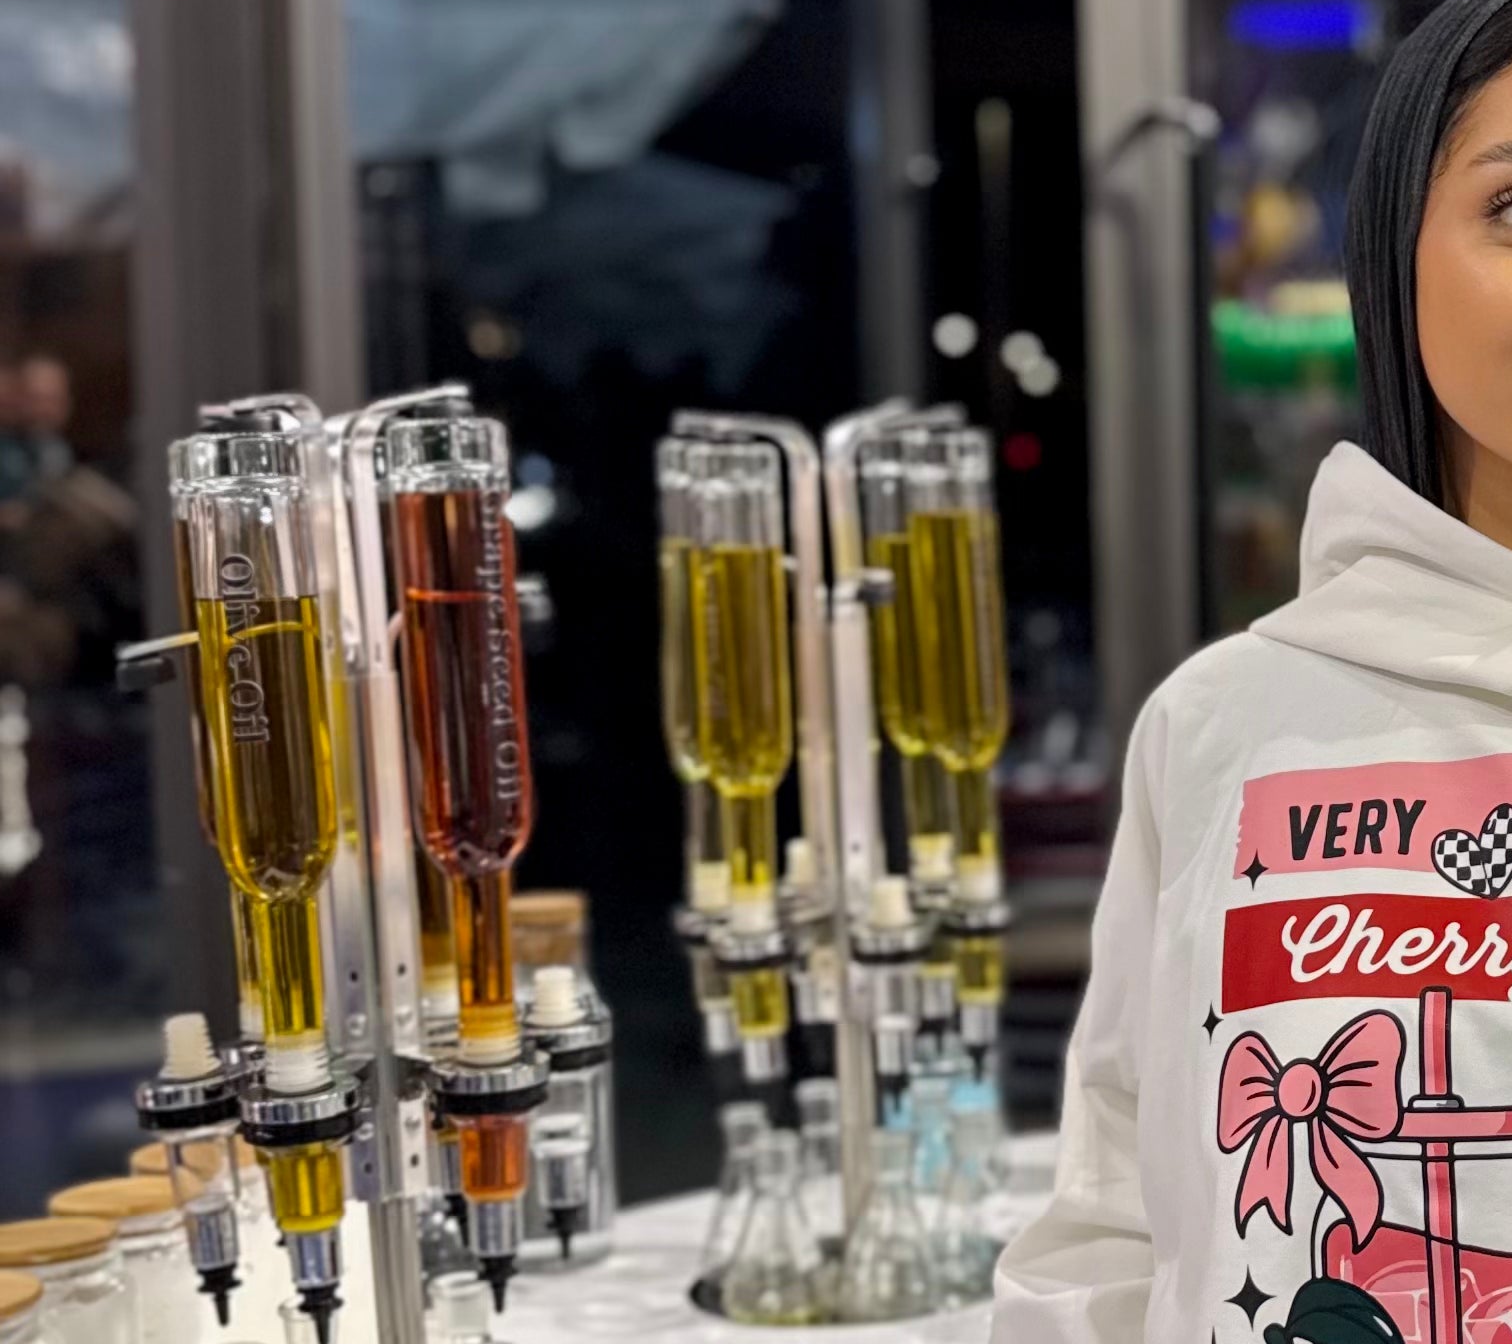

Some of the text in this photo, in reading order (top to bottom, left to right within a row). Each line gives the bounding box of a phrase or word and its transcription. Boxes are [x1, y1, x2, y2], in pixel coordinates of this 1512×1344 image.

[220, 552, 271, 743] Olive Oil
[497, 741, 522, 800] Oil
[1288, 797, 1427, 861] VERY
